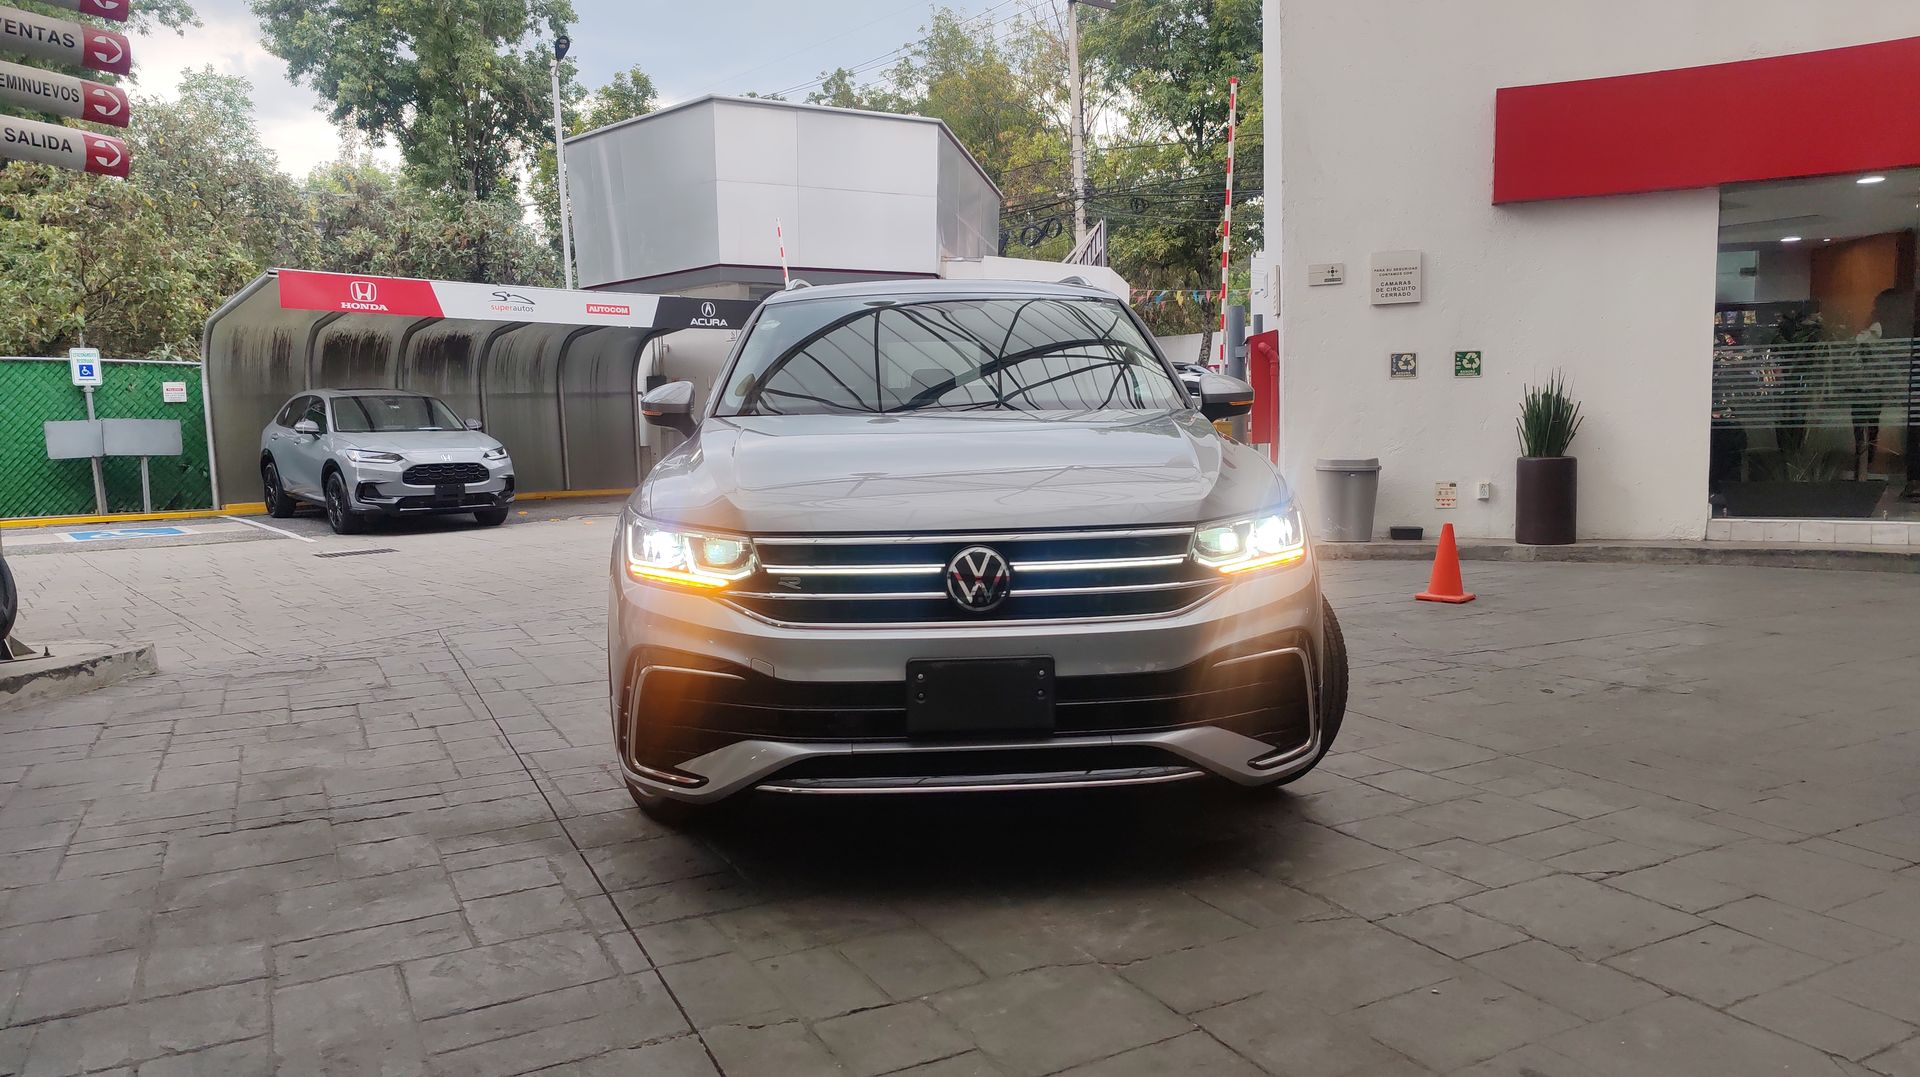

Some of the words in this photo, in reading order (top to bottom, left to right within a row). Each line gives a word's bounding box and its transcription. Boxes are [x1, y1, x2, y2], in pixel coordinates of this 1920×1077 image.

[0, 18, 75, 48] ENTAS
[4, 127, 73, 154] SALIDA
[340, 301, 389, 311] HONDA
[490, 304, 535, 313] superautos
[588, 306, 629, 314] AUTOCOM
[690, 317, 728, 327] ACURA
